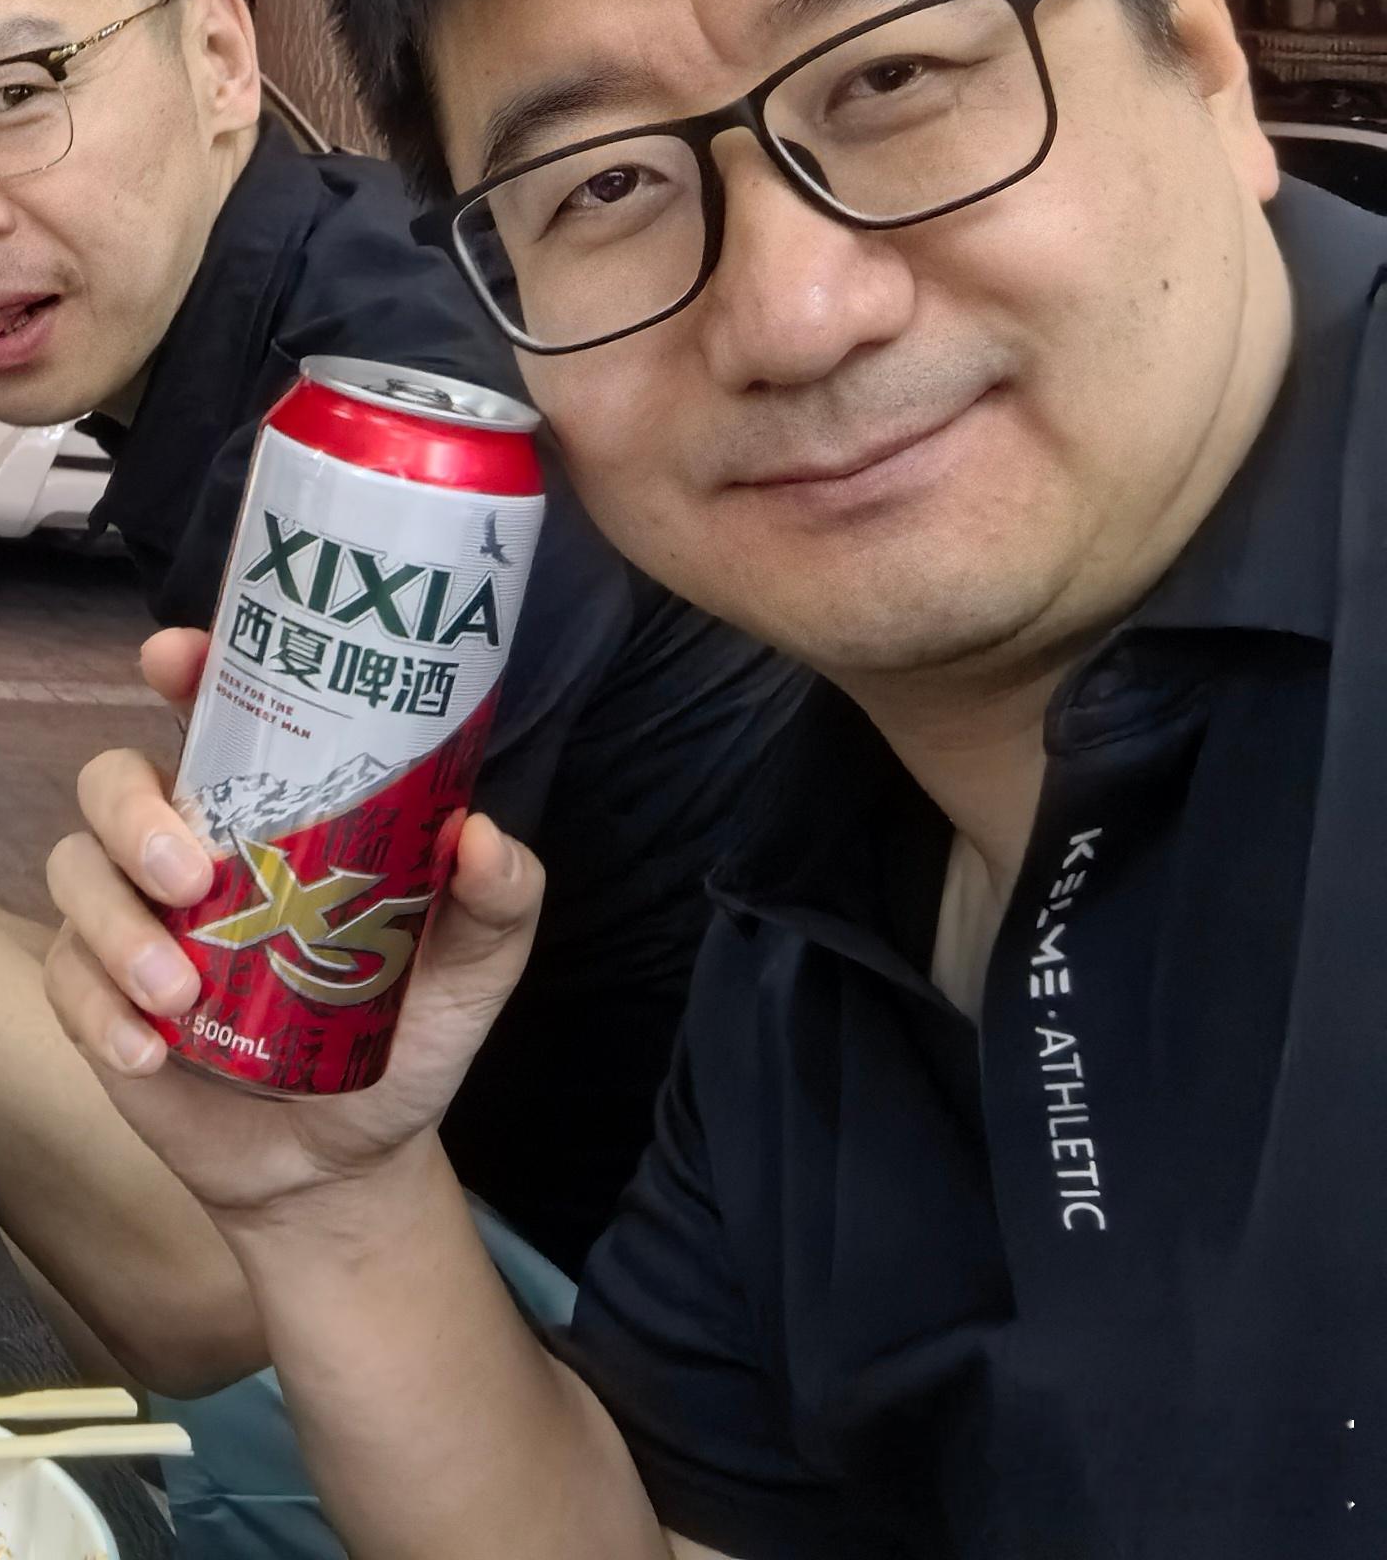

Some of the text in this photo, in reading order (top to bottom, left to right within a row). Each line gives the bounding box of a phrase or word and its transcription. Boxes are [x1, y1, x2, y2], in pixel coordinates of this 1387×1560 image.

[243, 510, 500, 648] XIXIA
[216, 682, 311, 739] NORTHWEST MAN
[228, 593, 460, 717] 西夏啤酒
[244, 685, 266, 703] FOR
[271, 697, 294, 716] THE
[187, 825, 436, 1007] X5
[192, 1014, 270, 1060] 500mL
[1035, 1026, 1106, 1231] ATHLETIC
